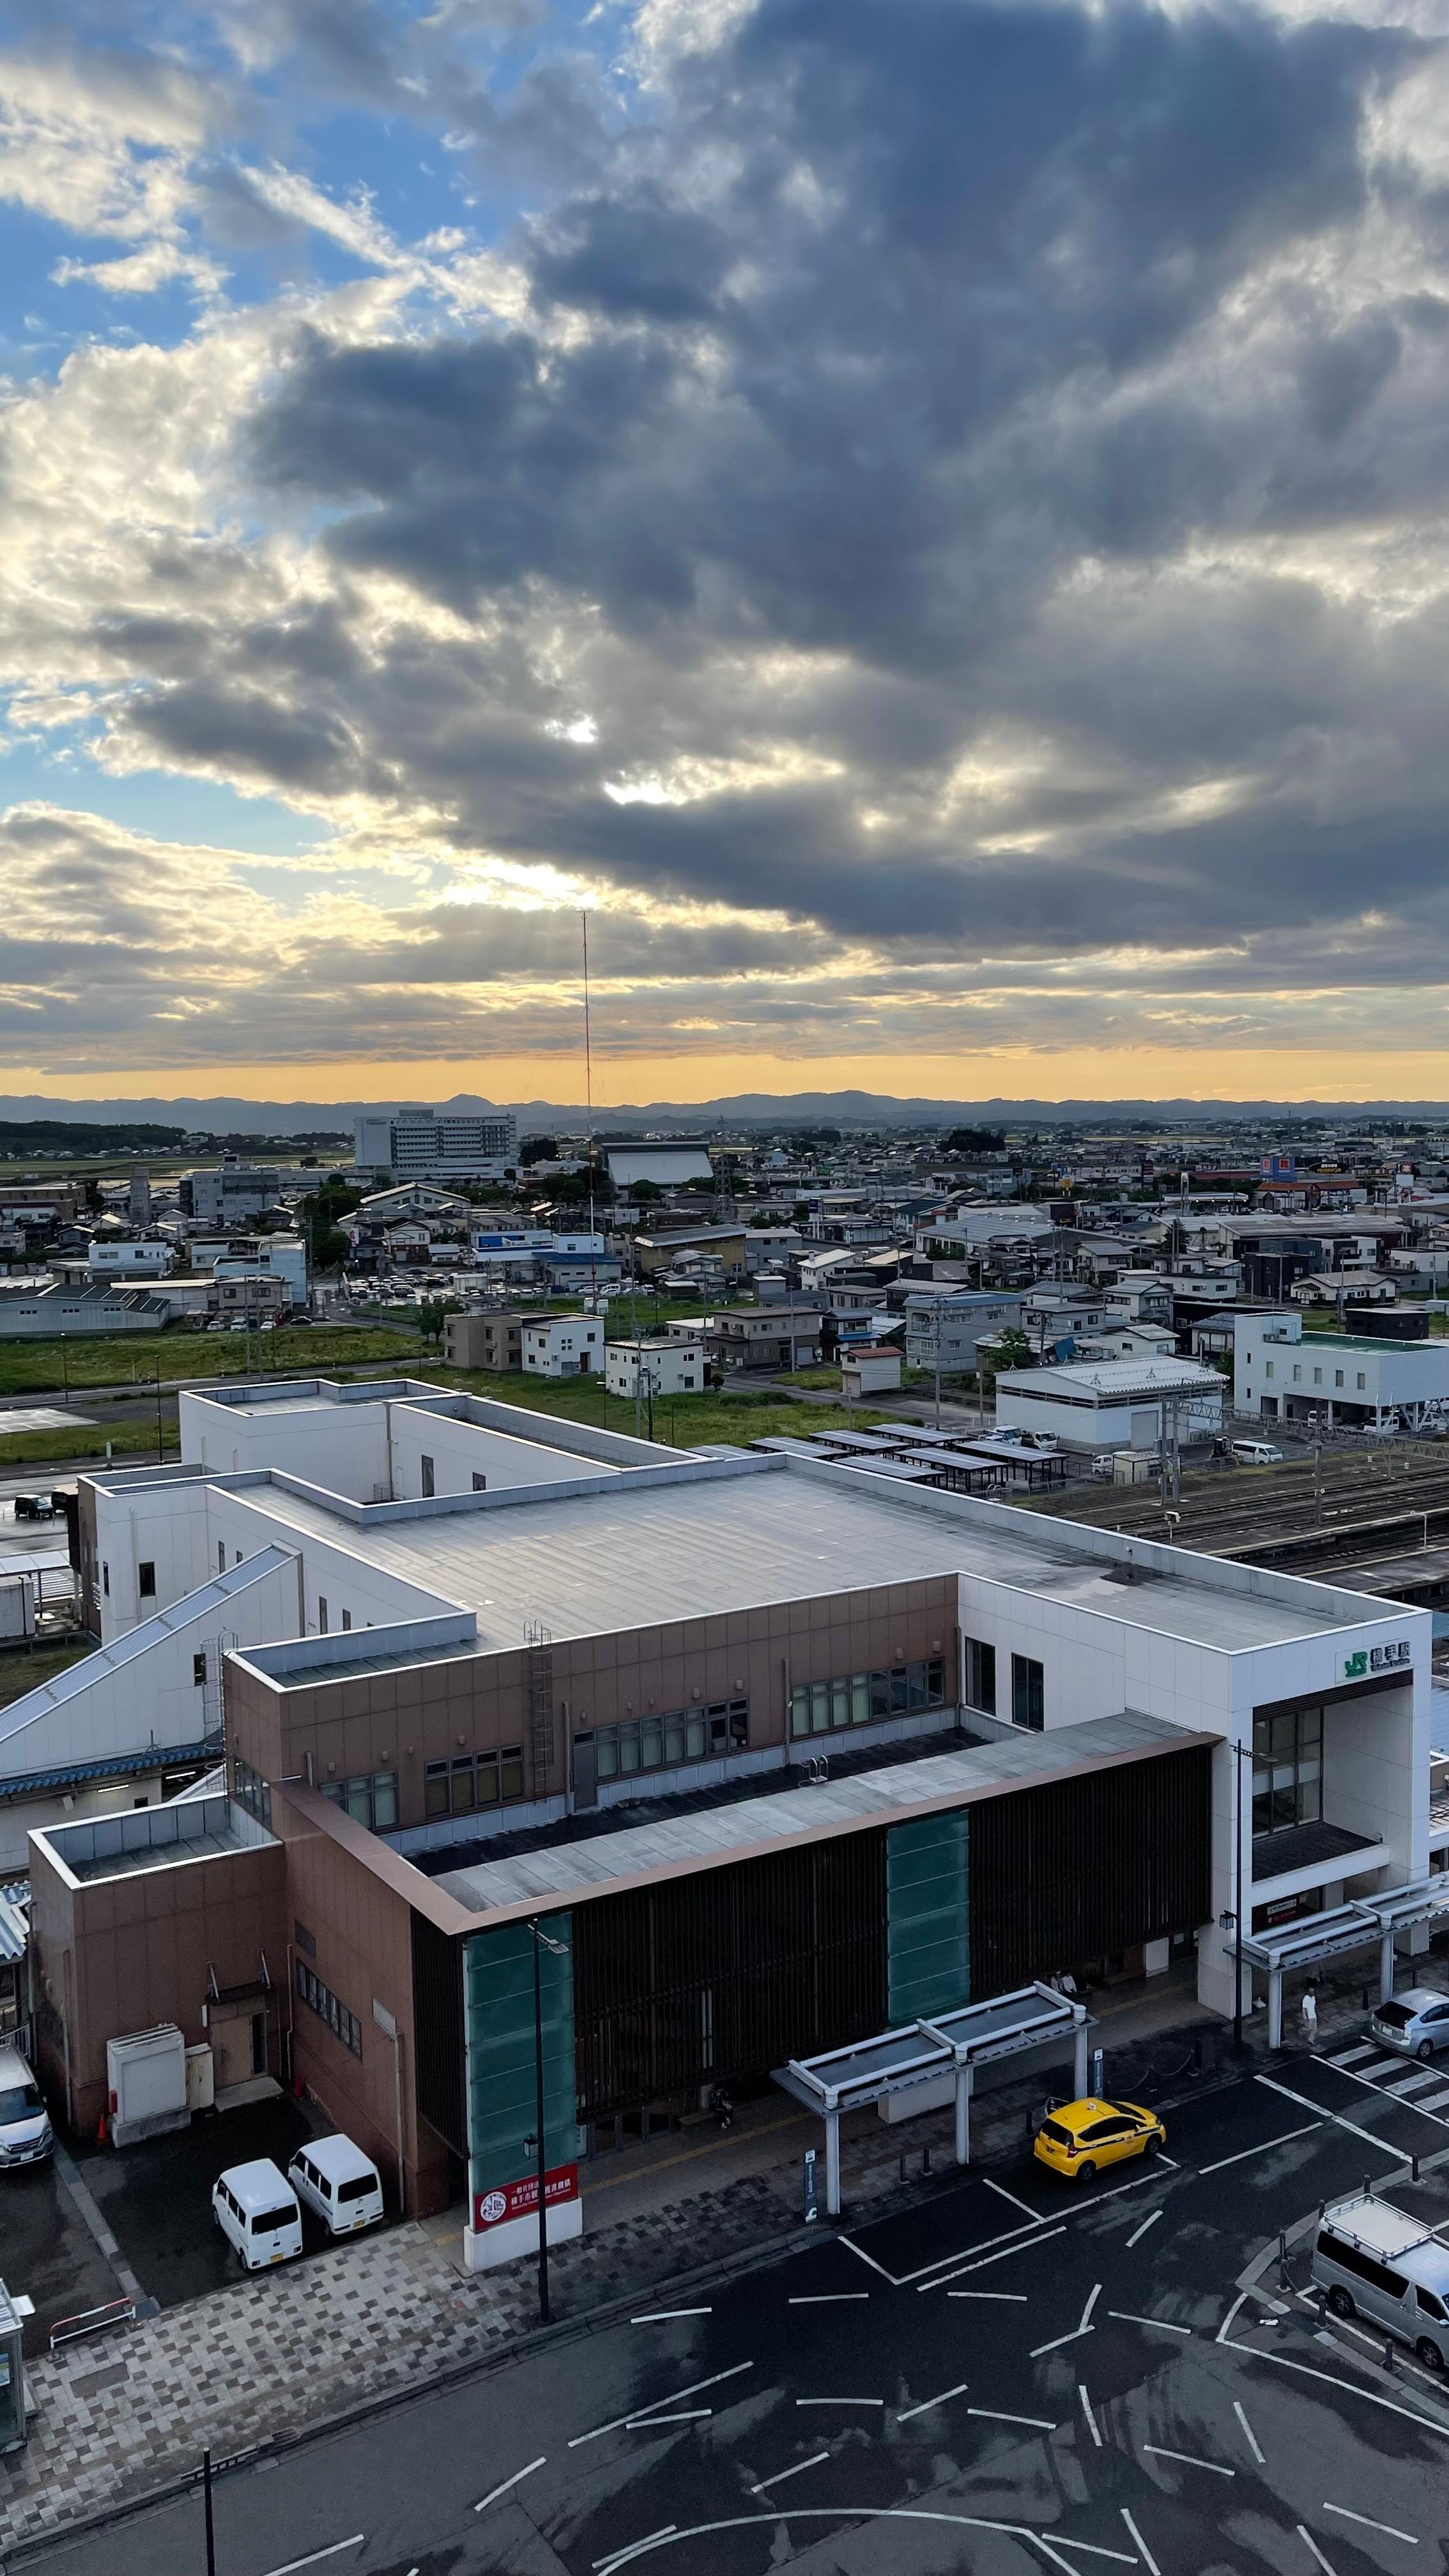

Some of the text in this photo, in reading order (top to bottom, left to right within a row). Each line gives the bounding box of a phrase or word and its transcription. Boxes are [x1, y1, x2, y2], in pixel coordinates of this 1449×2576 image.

[1345, 1641, 1410, 1677] JR 横手駅
